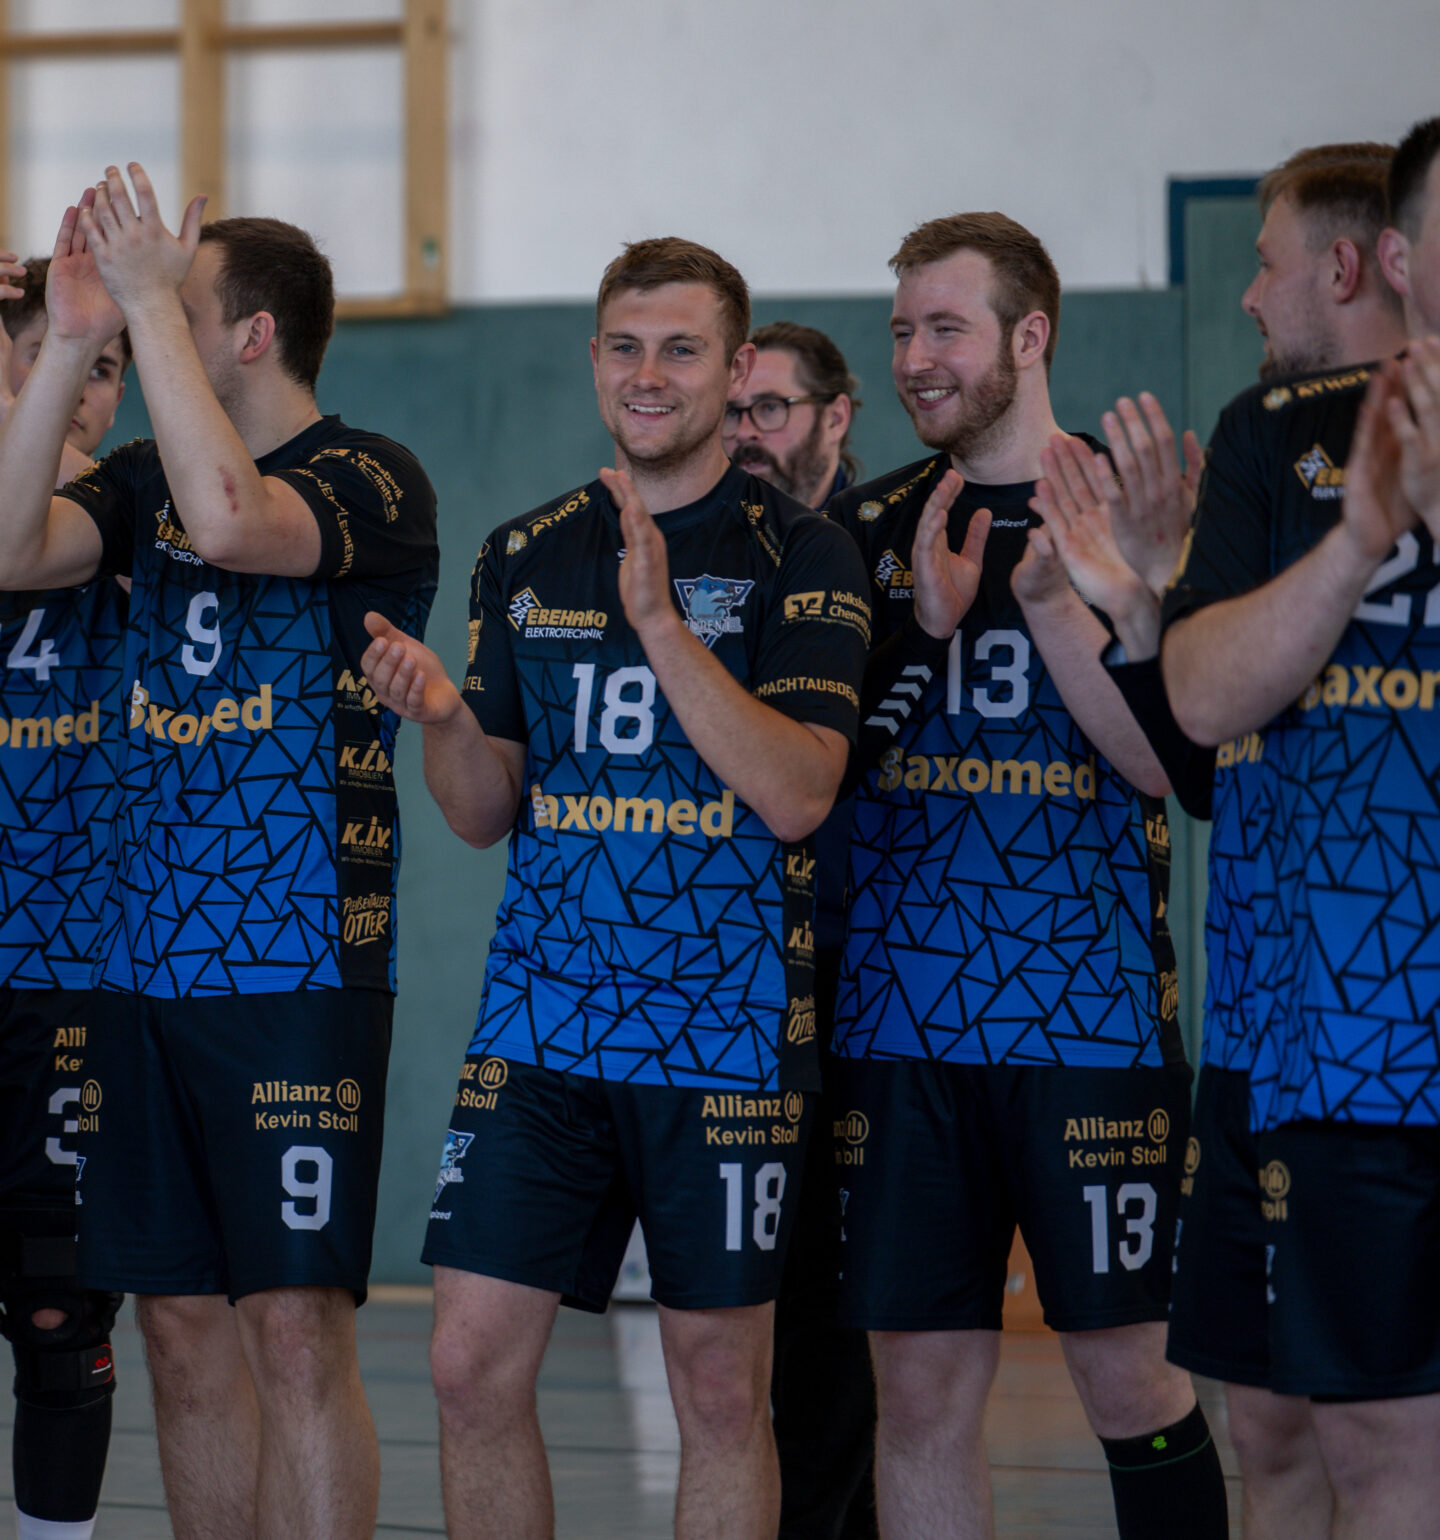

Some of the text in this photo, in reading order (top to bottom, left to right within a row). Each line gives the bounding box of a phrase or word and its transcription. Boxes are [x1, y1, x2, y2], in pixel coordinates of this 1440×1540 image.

[531, 490, 591, 538] ATHOS
[991, 518, 1029, 529] spized
[525, 608, 609, 629] EBEHAKO
[181, 590, 223, 677] 9
[524, 627, 606, 641] ELEKTROTECHNIK
[946, 629, 1030, 718] 13
[572, 663, 657, 755] 18
[877, 745, 1096, 800] Saxomed
[343, 909, 389, 944] OTTER
[53, 1027, 87, 1048] Alli
[251, 1081, 332, 1105] Allianz
[461, 1087, 499, 1111] Stoll
[701, 1095, 782, 1119] Allianz
[45, 1088, 82, 1166] 3
[77, 1115, 100, 1132] toll
[255, 1110, 359, 1133] Kevin Stoll
[1063, 1118, 1144, 1142] Allianz
[705, 1123, 799, 1146] Kevin Stoll
[1068, 1146, 1167, 1169] Kevin Stoll
[281, 1145, 334, 1231] 9
[719, 1162, 788, 1251] 18
[1082, 1183, 1158, 1274] 13
